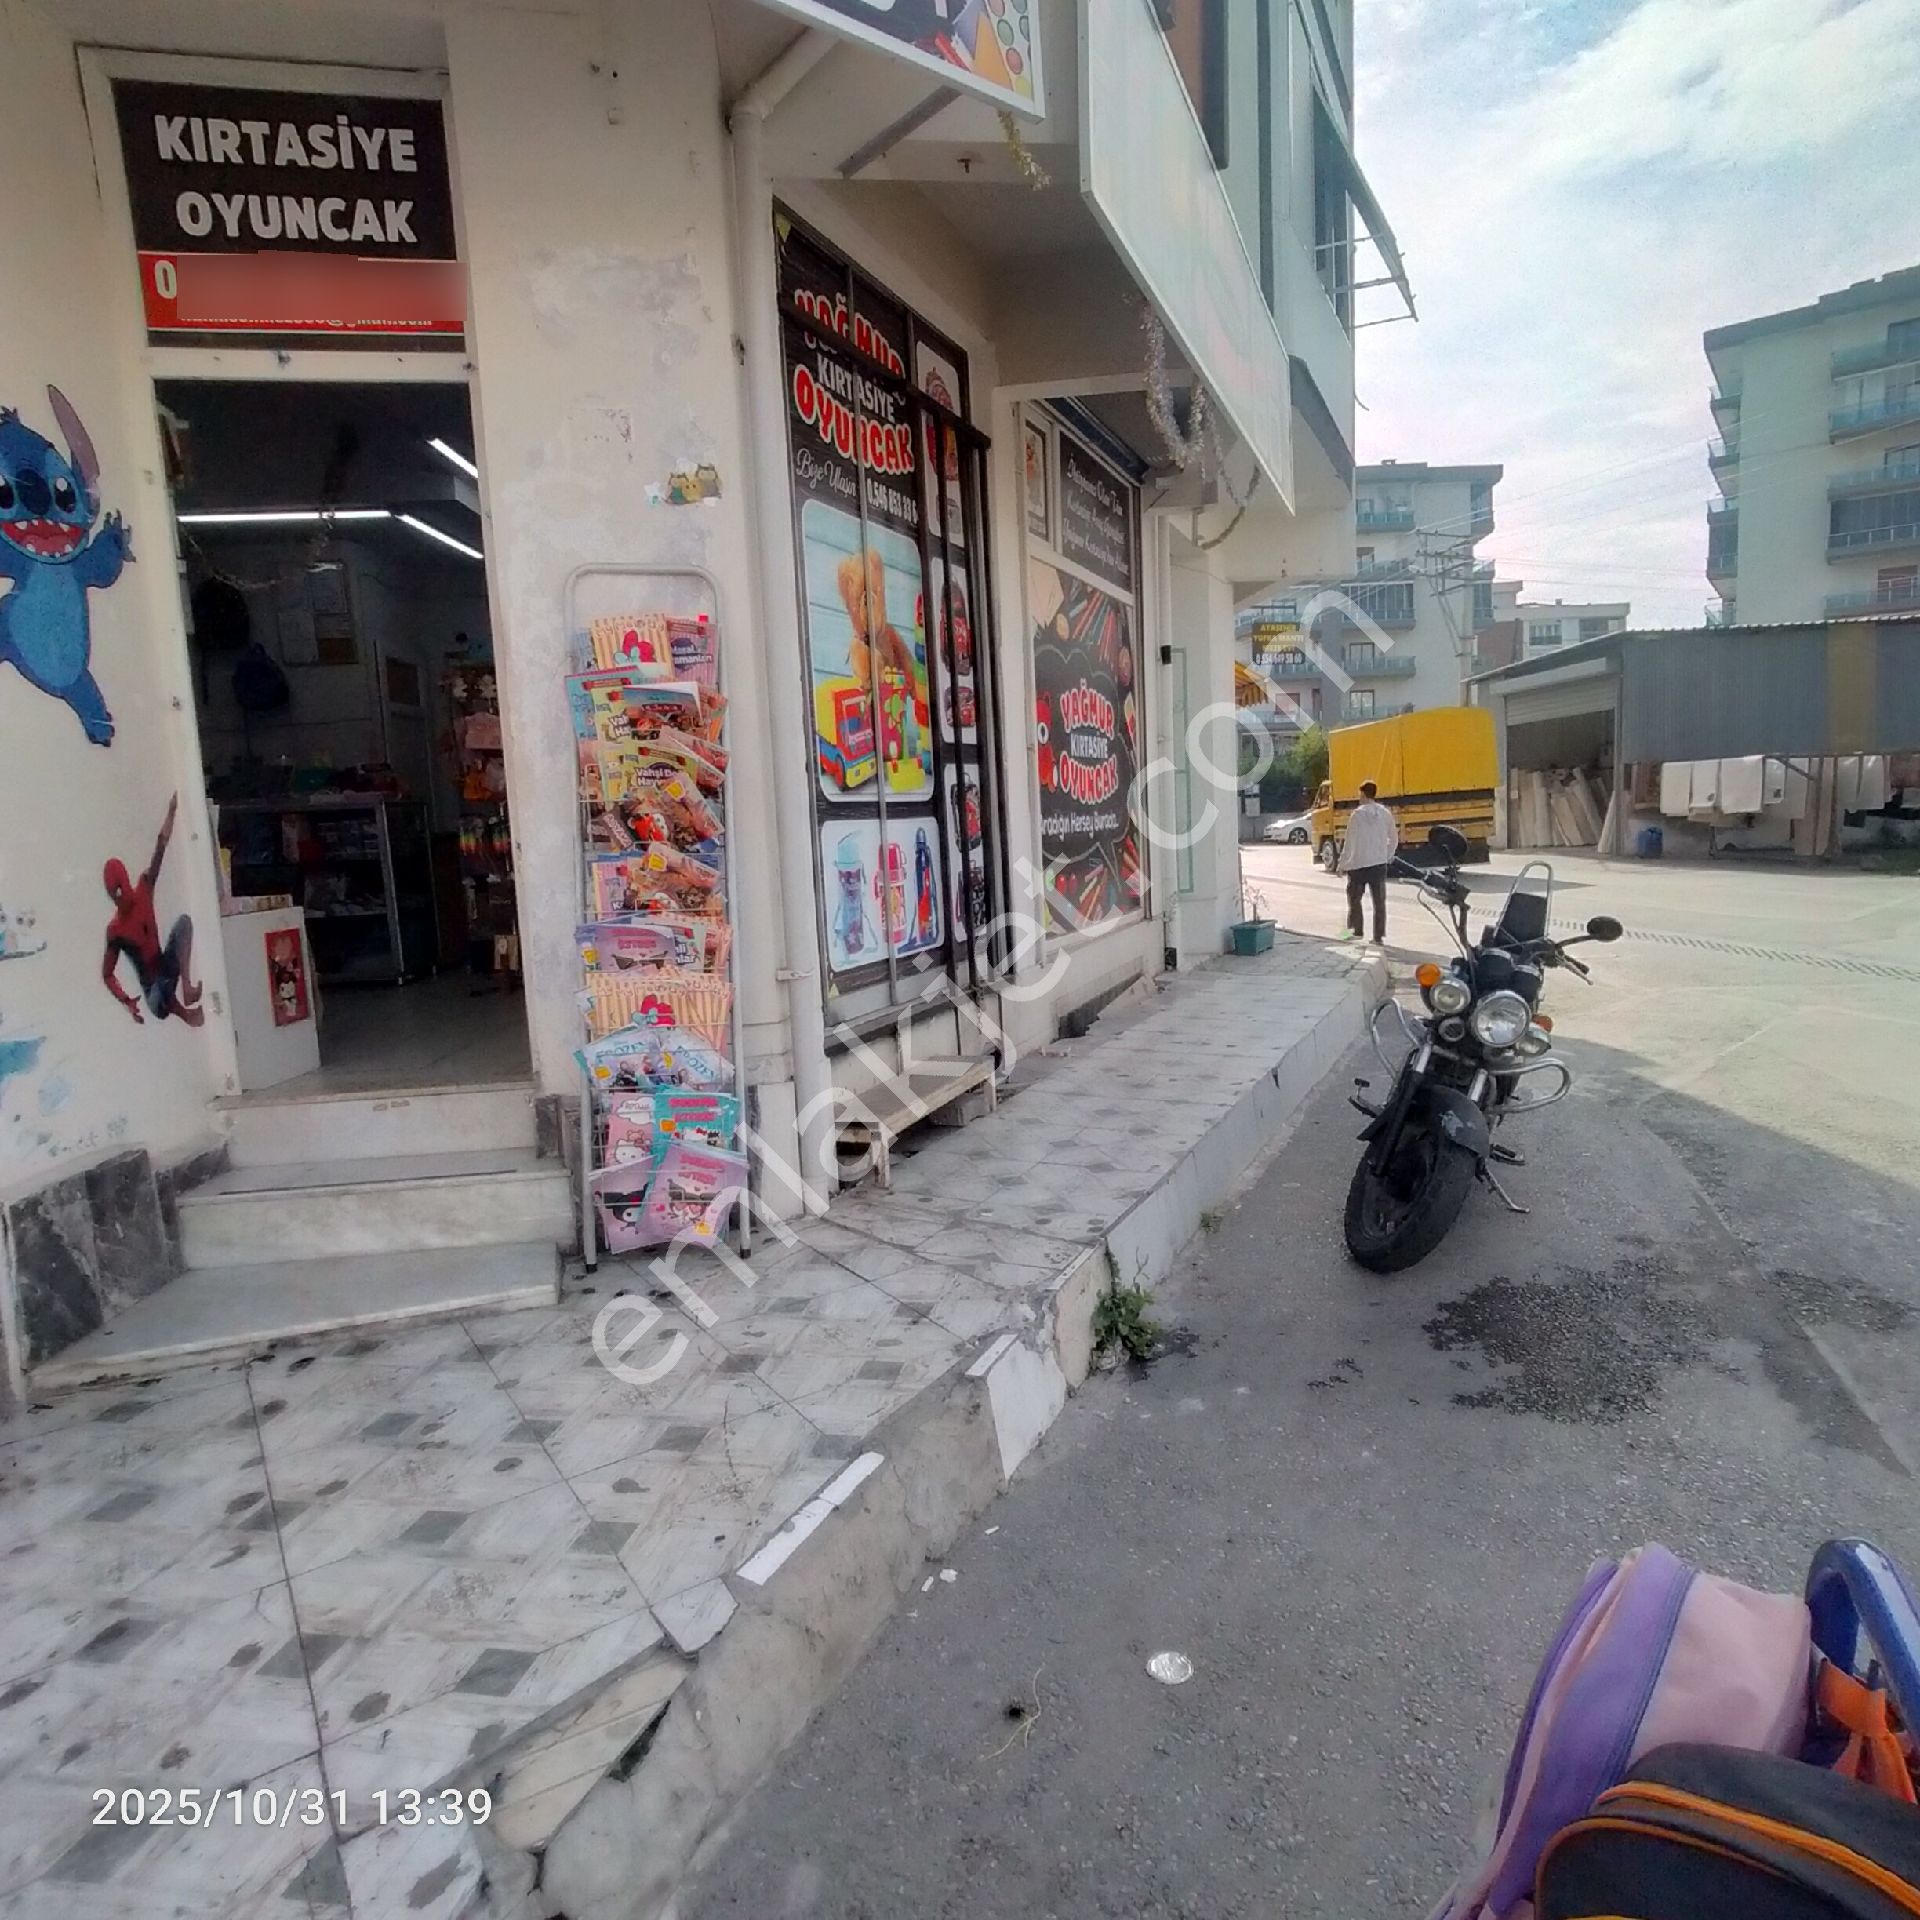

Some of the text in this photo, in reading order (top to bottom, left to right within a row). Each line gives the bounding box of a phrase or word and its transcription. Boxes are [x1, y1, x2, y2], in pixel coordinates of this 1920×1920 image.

[154, 114, 418, 172] KIRTASİYE
[175, 191, 418, 243] OYUNCAK
[1060, 677, 1114, 741] YAĞMUR
[1070, 731, 1109, 759] KIRTASİYE
[1059, 750, 1119, 806] OYUNCAK
